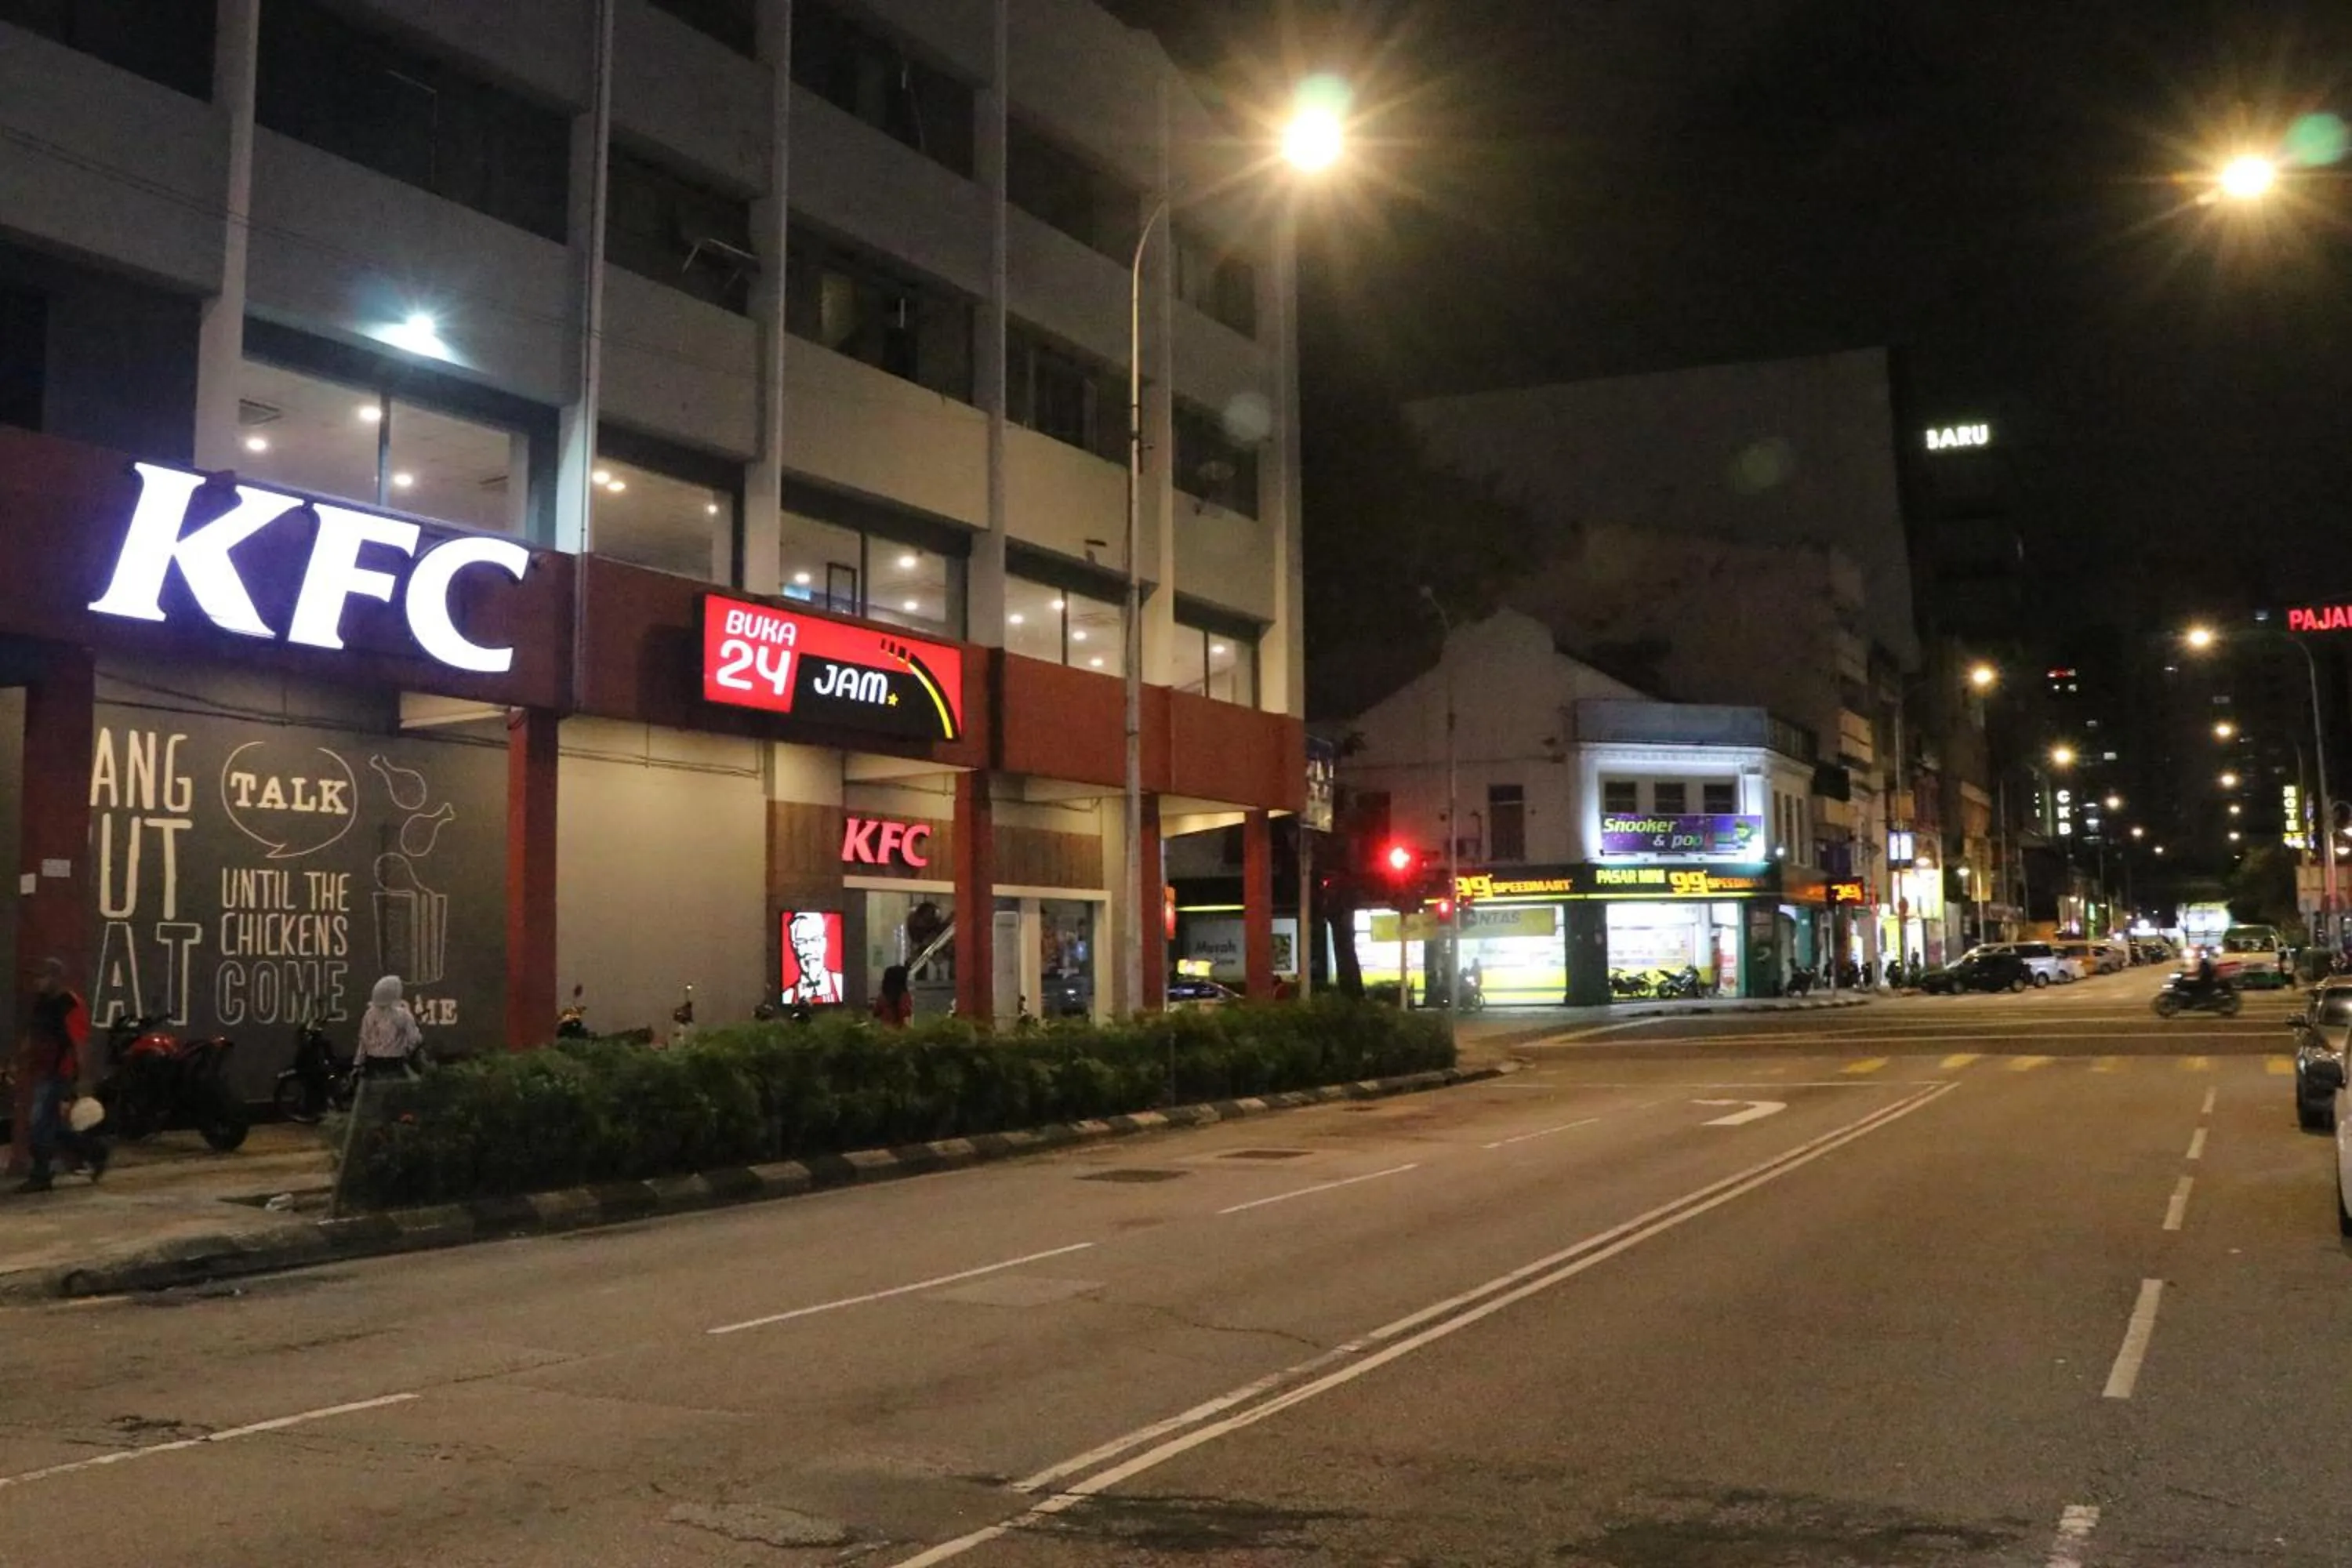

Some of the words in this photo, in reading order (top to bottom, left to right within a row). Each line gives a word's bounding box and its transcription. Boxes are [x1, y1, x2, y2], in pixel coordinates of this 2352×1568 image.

[87, 462, 530, 673] KFC
[725, 609, 797, 645] BUKA
[716, 639, 791, 696] 24
[813, 664, 888, 704] JAM
[230, 771, 348, 815] TALK
[841, 817, 931, 867] KFC
[1603, 818, 1676, 833] Snooker
[1653, 835, 1665, 847] &
[89, 813, 193, 920] UT
[1492, 879, 1571, 894] SPEEDMART
[1595, 869, 1637, 884] PASAR
[1669, 871, 1709, 895] 99
[221, 867, 297, 910] UNTIL
[303, 872, 351, 912] THE
[220, 912, 348, 956] CHICKENS
[215, 960, 348, 1025] COME
